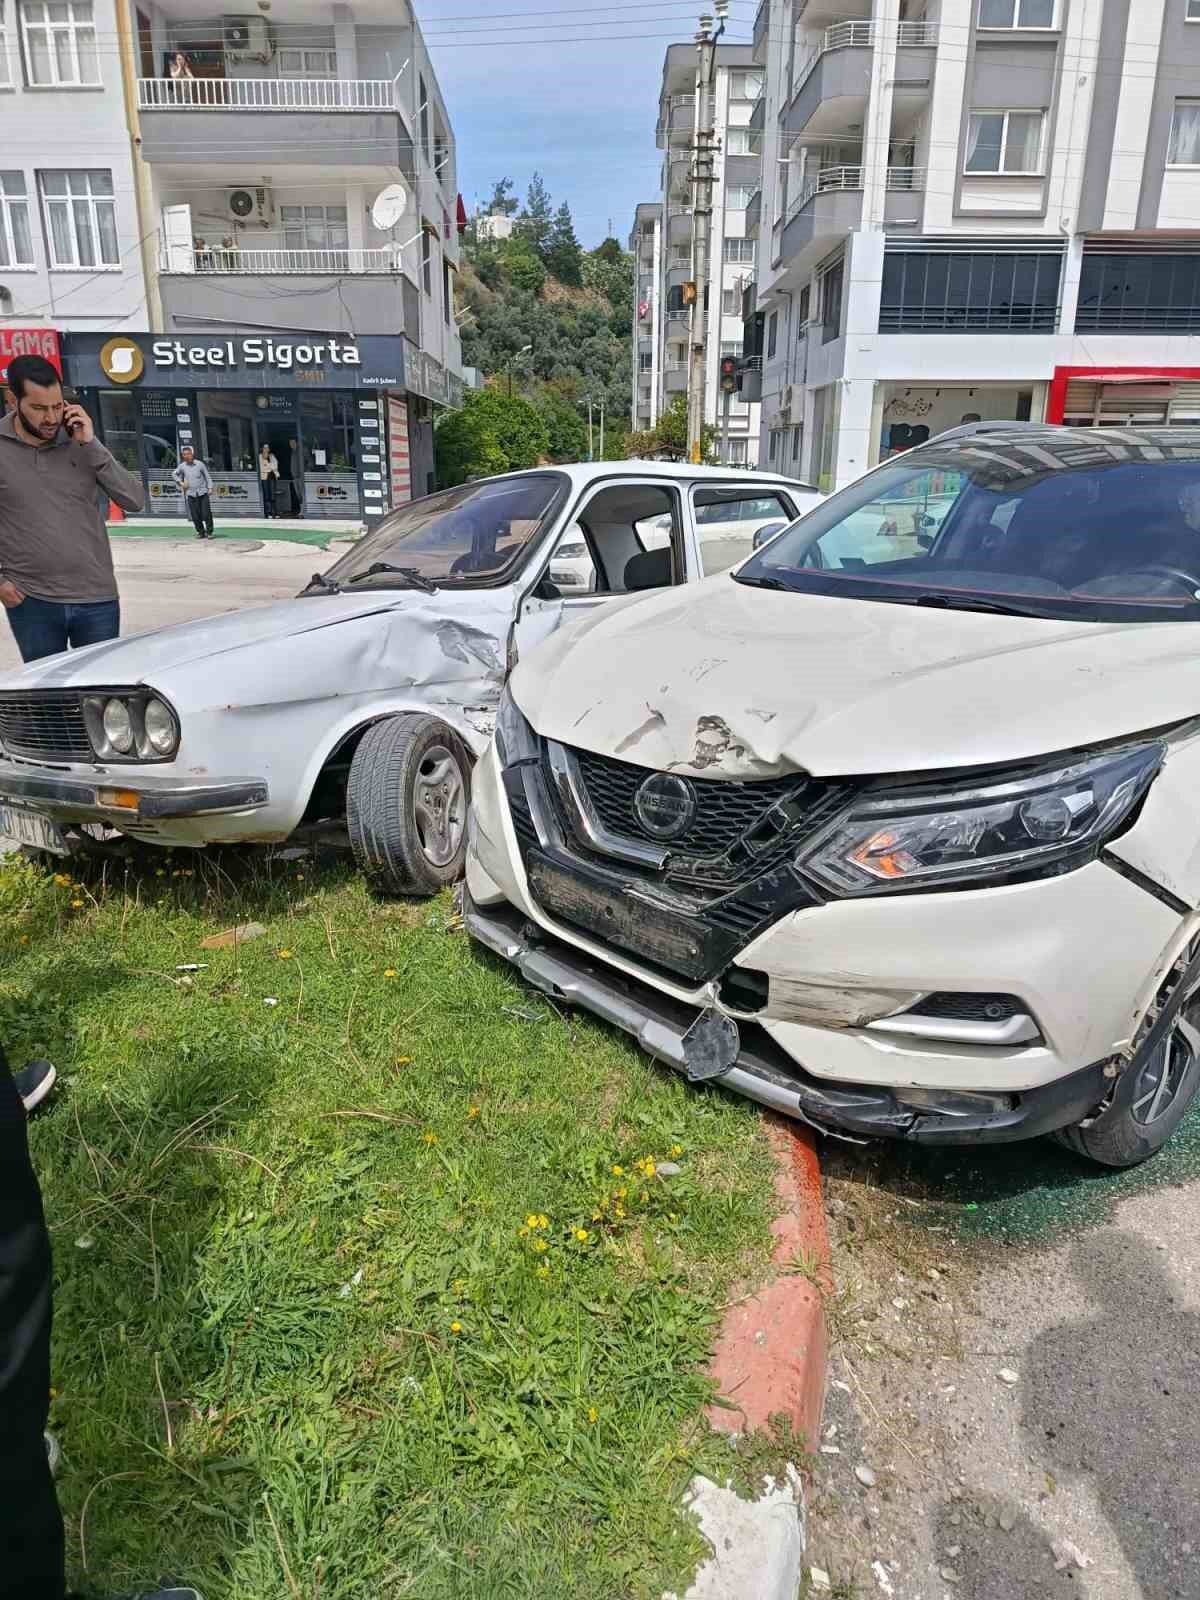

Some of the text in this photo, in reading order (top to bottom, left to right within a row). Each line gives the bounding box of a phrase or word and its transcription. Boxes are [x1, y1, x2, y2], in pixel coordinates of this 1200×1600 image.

[0, 332, 54, 356] LAMA
[152, 338, 361, 368] Steel Sigorta
[640, 792, 687, 812] NISSAN
